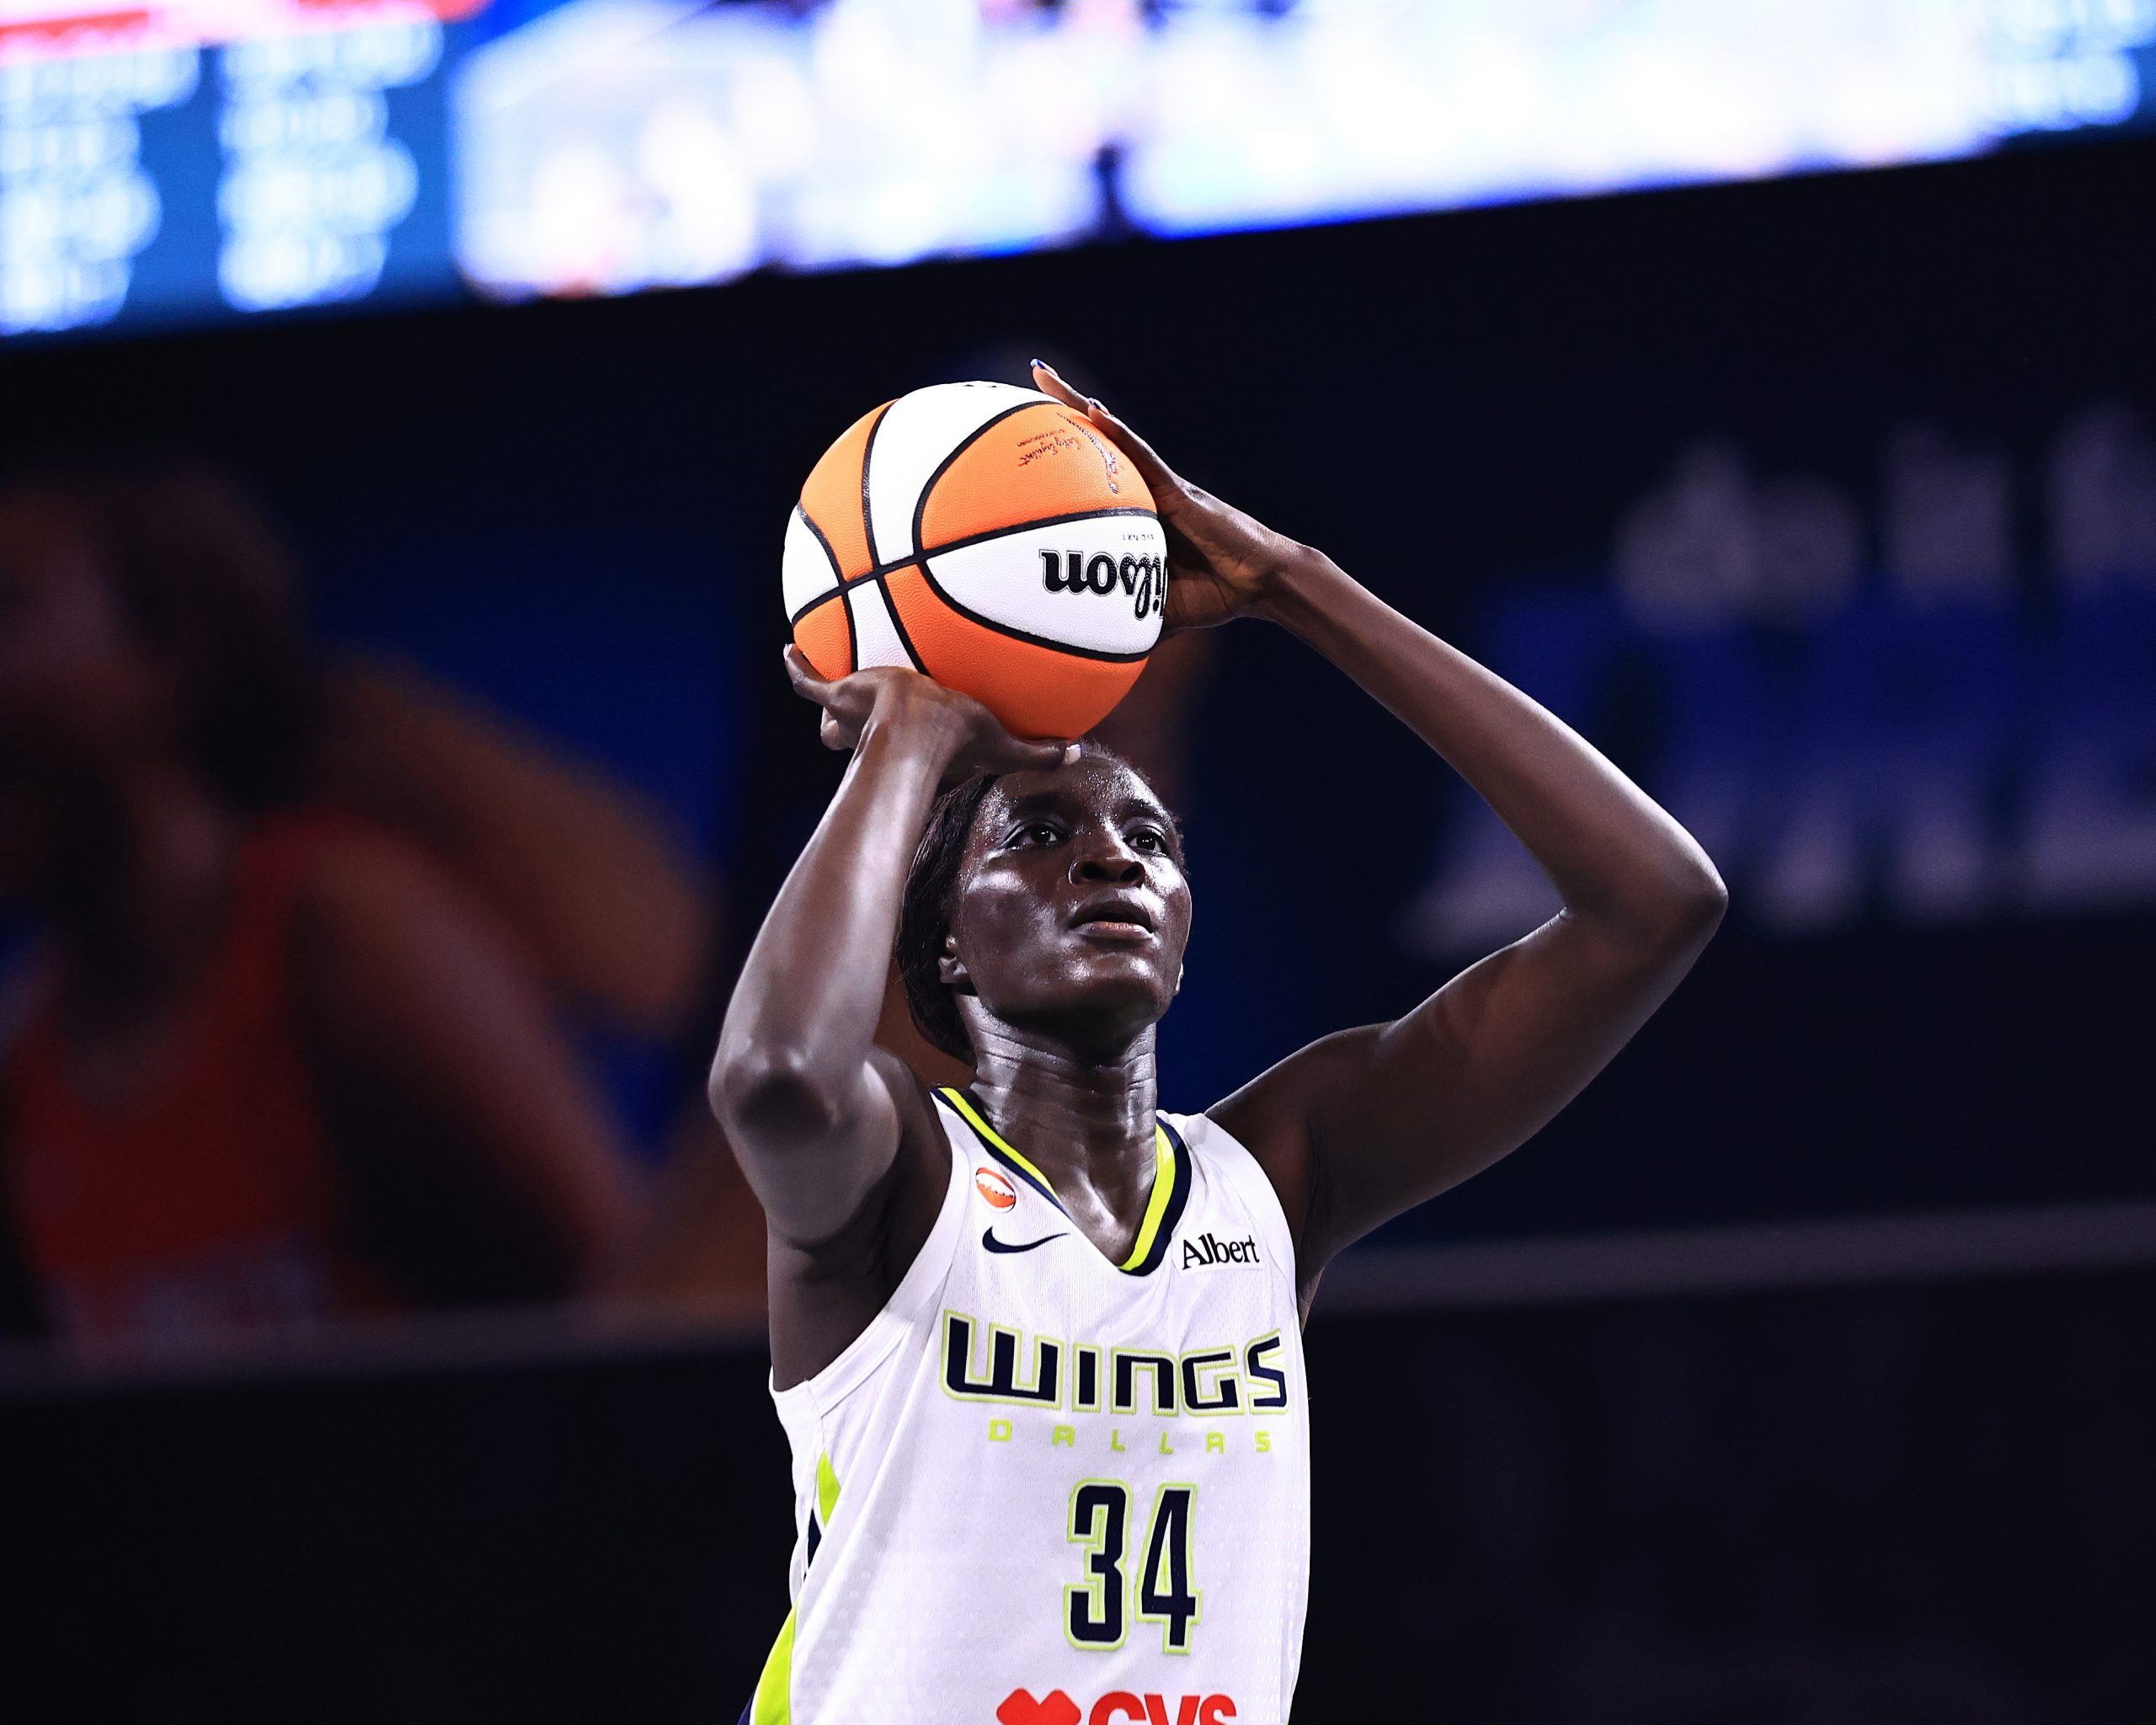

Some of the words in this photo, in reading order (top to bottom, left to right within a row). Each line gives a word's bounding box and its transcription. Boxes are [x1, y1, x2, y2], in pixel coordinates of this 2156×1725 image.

[1182, 1232, 1260, 1270] Albert
[940, 1309, 1289, 1417] WINGS
[989, 1418, 1272, 1455] DALLAS
[1064, 1477, 1203, 1655] 34
